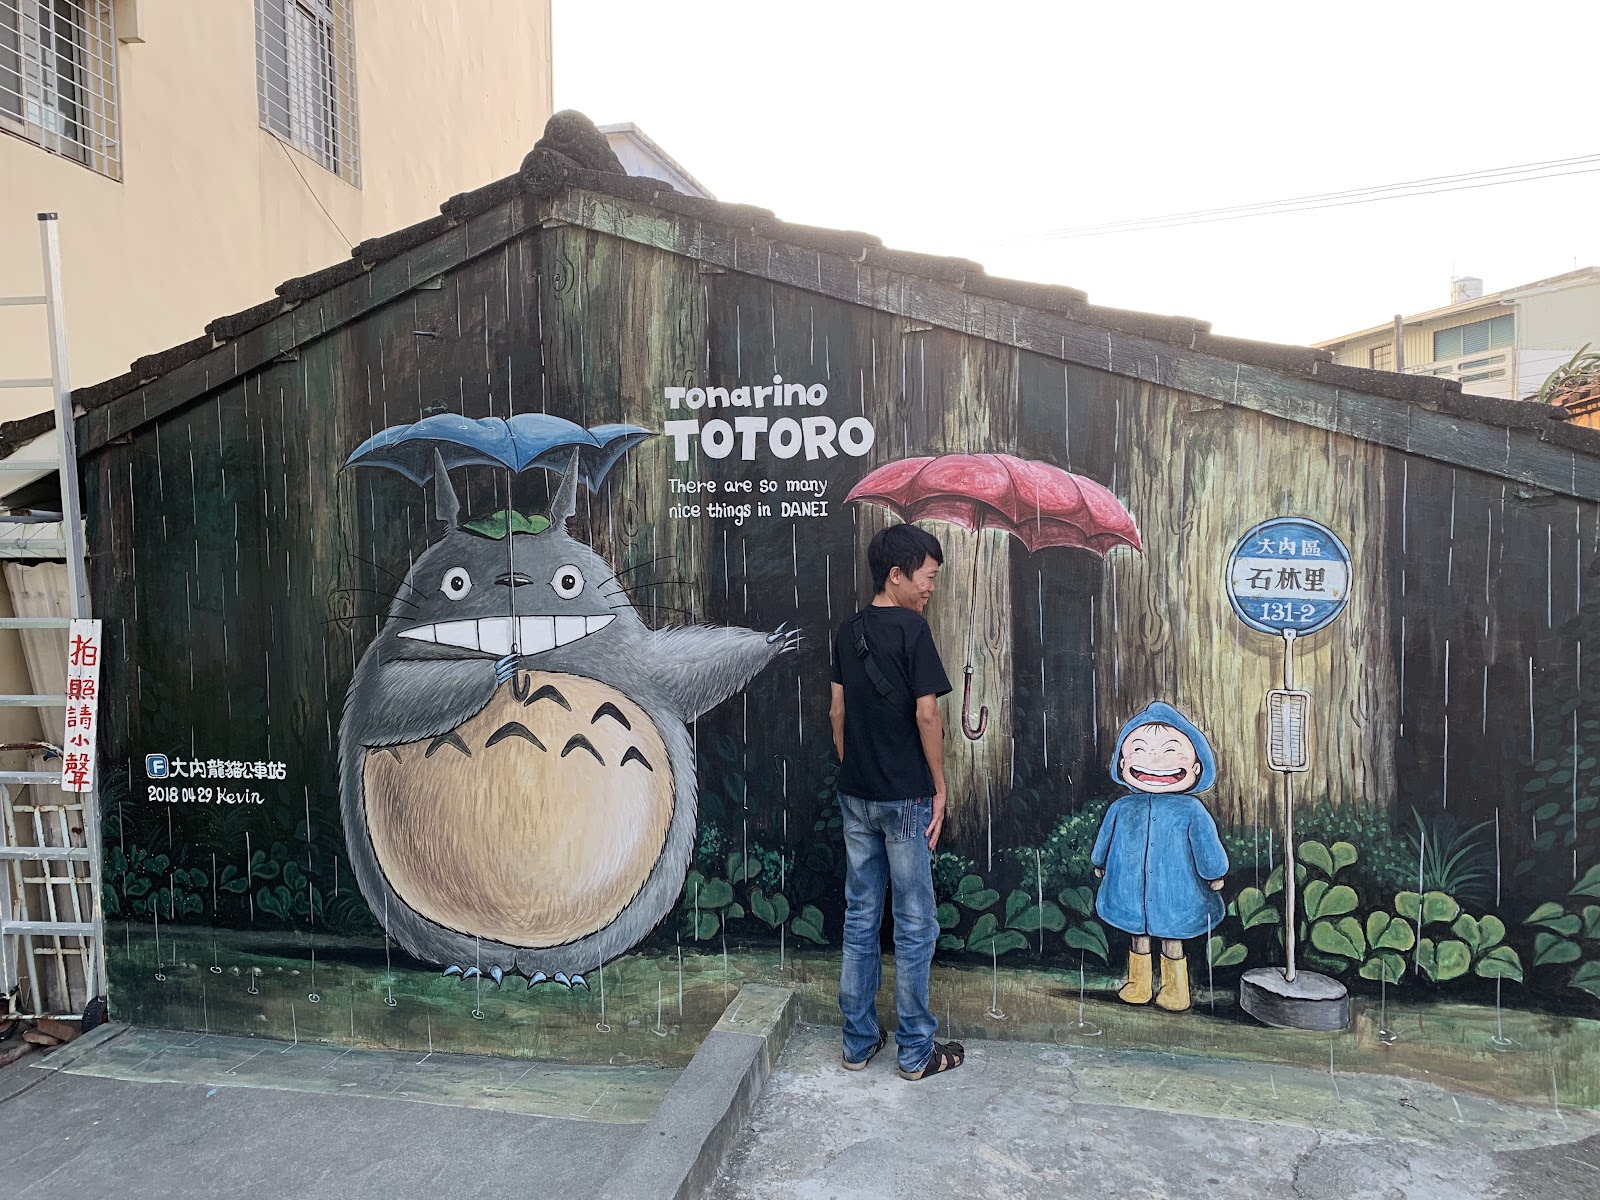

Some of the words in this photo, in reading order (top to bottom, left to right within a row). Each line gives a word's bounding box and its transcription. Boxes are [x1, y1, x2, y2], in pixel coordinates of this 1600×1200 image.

[664, 374, 828, 410] Tonarino
[664, 415, 875, 462] TOTORO
[668, 478, 717, 494] There
[724, 480, 753, 494] are
[759, 478, 778, 493] so
[786, 479, 828, 498] many
[668, 503, 701, 519] nice
[706, 502, 752, 527] things
[757, 502, 772, 517] in
[781, 501, 829, 518] DANEI
[1245, 567, 1326, 593] 石林里
[1260, 602, 1316, 623] 131-2
[64, 634, 98, 792] 拍照請小聲
[147, 785, 179, 803] 2018
[181, 787, 197, 803] 04
[197, 786, 213, 803] 29
[215, 786, 265, 805] Kevin
